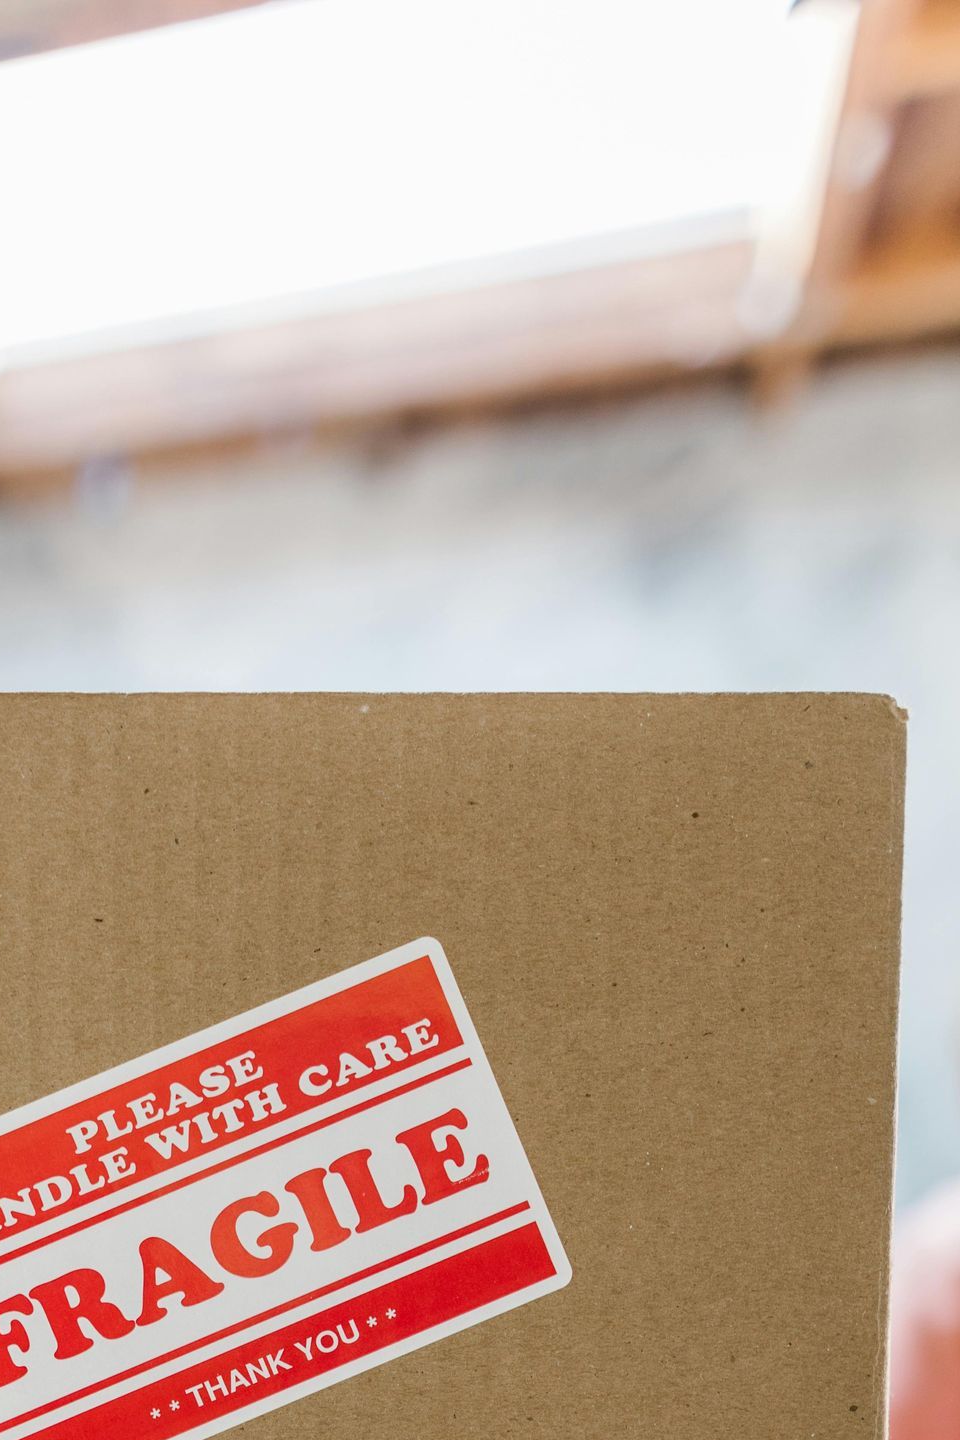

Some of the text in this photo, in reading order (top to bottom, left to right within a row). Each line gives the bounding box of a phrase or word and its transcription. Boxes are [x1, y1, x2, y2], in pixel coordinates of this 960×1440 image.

[66, 1050, 264, 1154] PLEASE
[144, 1083, 287, 1161] WITH
[298, 1018, 440, 1096] CARE
[185, 1319, 362, 1408] THANK YOU
